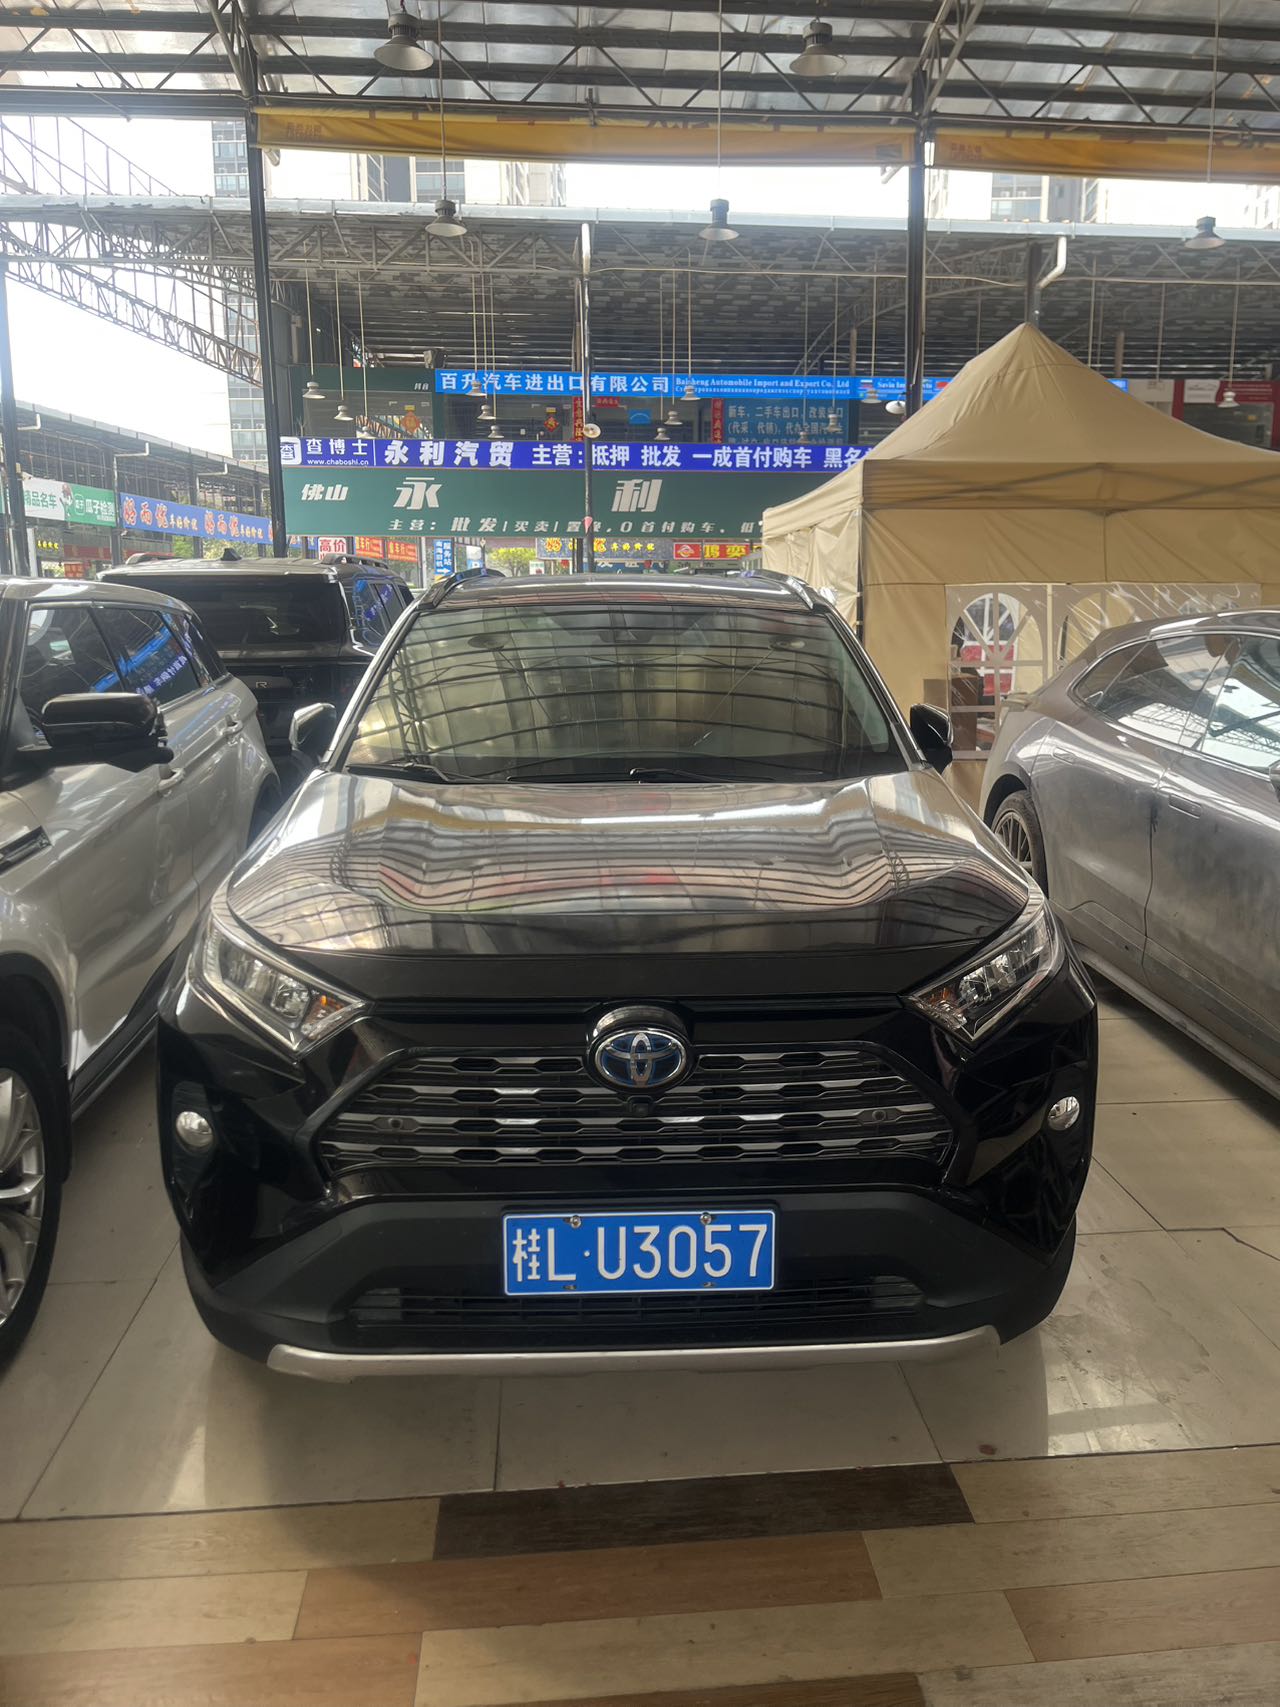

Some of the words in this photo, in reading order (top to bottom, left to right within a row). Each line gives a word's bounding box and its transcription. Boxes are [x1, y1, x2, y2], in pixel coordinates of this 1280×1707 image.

[711, 378, 752, 387] Automobile
[754, 379, 777, 389] Import
[780, 379, 794, 388] and
[306, 439, 368, 455] 查博士
[384, 440, 514, 467] 永利汽贸
[641, 445, 681, 467] 批发
[692, 446, 812, 469] 一成首付购车
[823, 447, 873, 468] 黑名
[307, 458, 369, 466] www.chaboshi.cn
[301, 484, 349, 501] 佛山
[611, 479, 663, 512] 利
[319, 539, 346, 553] 高价
[512, 1224, 767, 1282] 桂L·U3057
